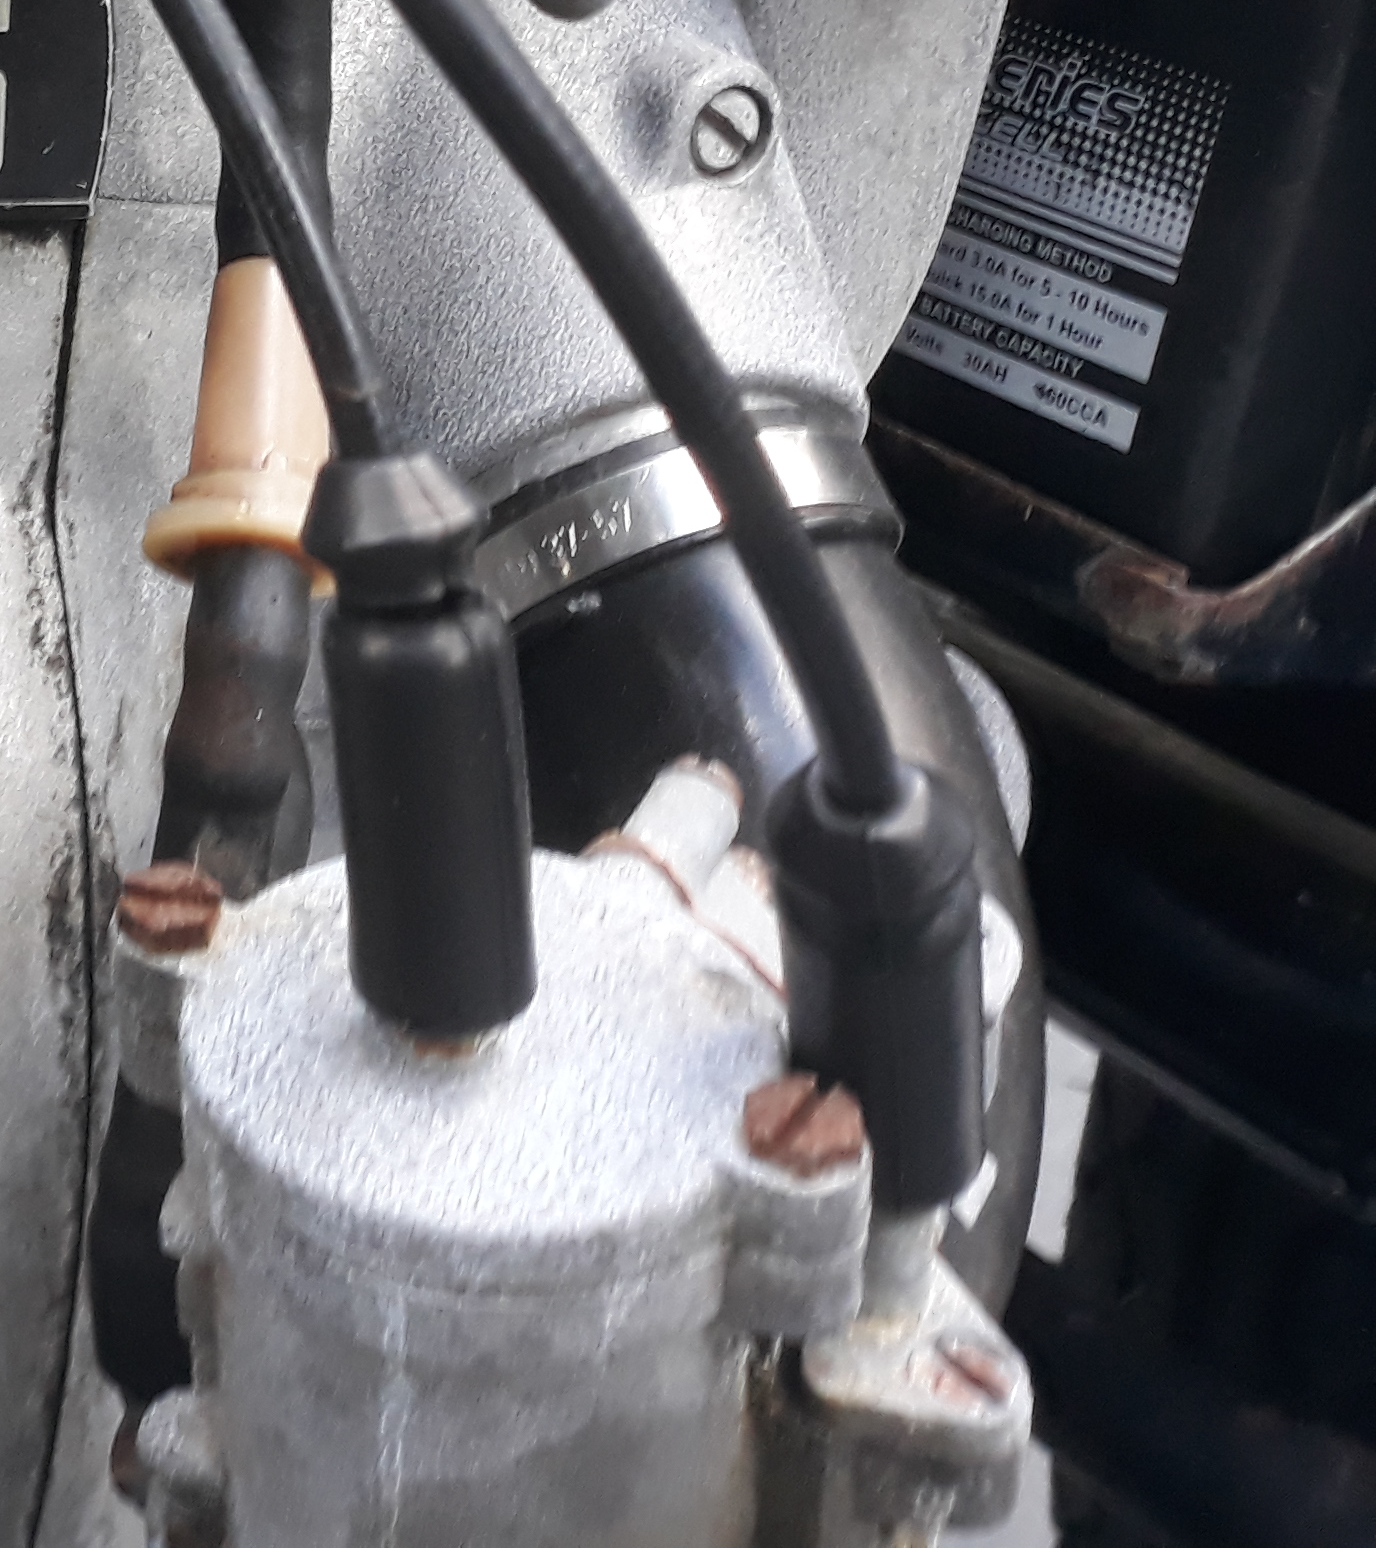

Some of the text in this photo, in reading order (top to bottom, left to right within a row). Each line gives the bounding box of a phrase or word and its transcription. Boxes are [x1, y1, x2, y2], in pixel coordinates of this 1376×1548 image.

[1035, 238, 1113, 284] METHOD
[1012, 263, 1037, 290] for
[1069, 288, 1090, 312] 10
[1094, 297, 1151, 338] Hours
[1015, 300, 1041, 324] for
[1059, 316, 1106, 351] Hour
[918, 293, 1086, 380] BATTERY CAPACITY
